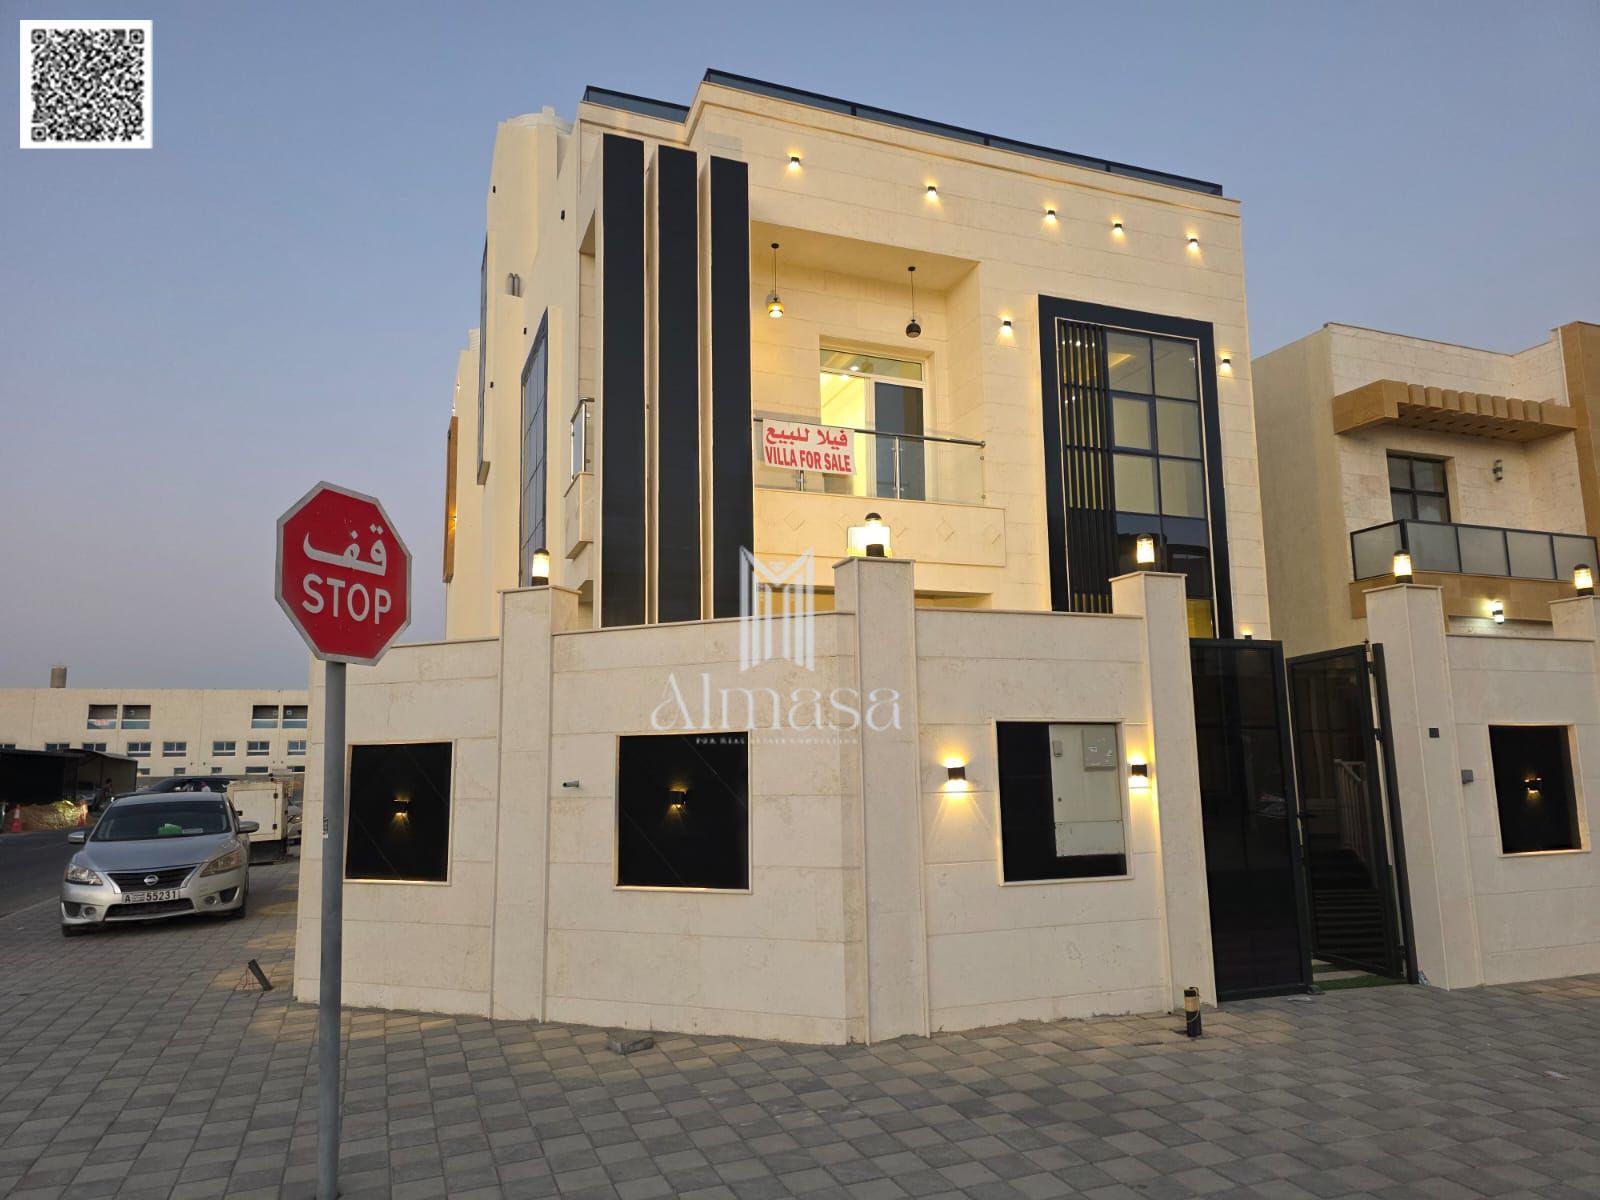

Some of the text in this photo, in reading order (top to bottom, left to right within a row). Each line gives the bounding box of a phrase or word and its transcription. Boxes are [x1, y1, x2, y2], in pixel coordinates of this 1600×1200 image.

[766, 426, 848, 450] فيلا للبيع
[765, 445, 852, 473] VILLA FOR SALE
[303, 522, 387, 577] قف
[302, 572, 392, 625] STOP
[124, 894, 132, 904] A
[146, 890, 177, 902] 55231
